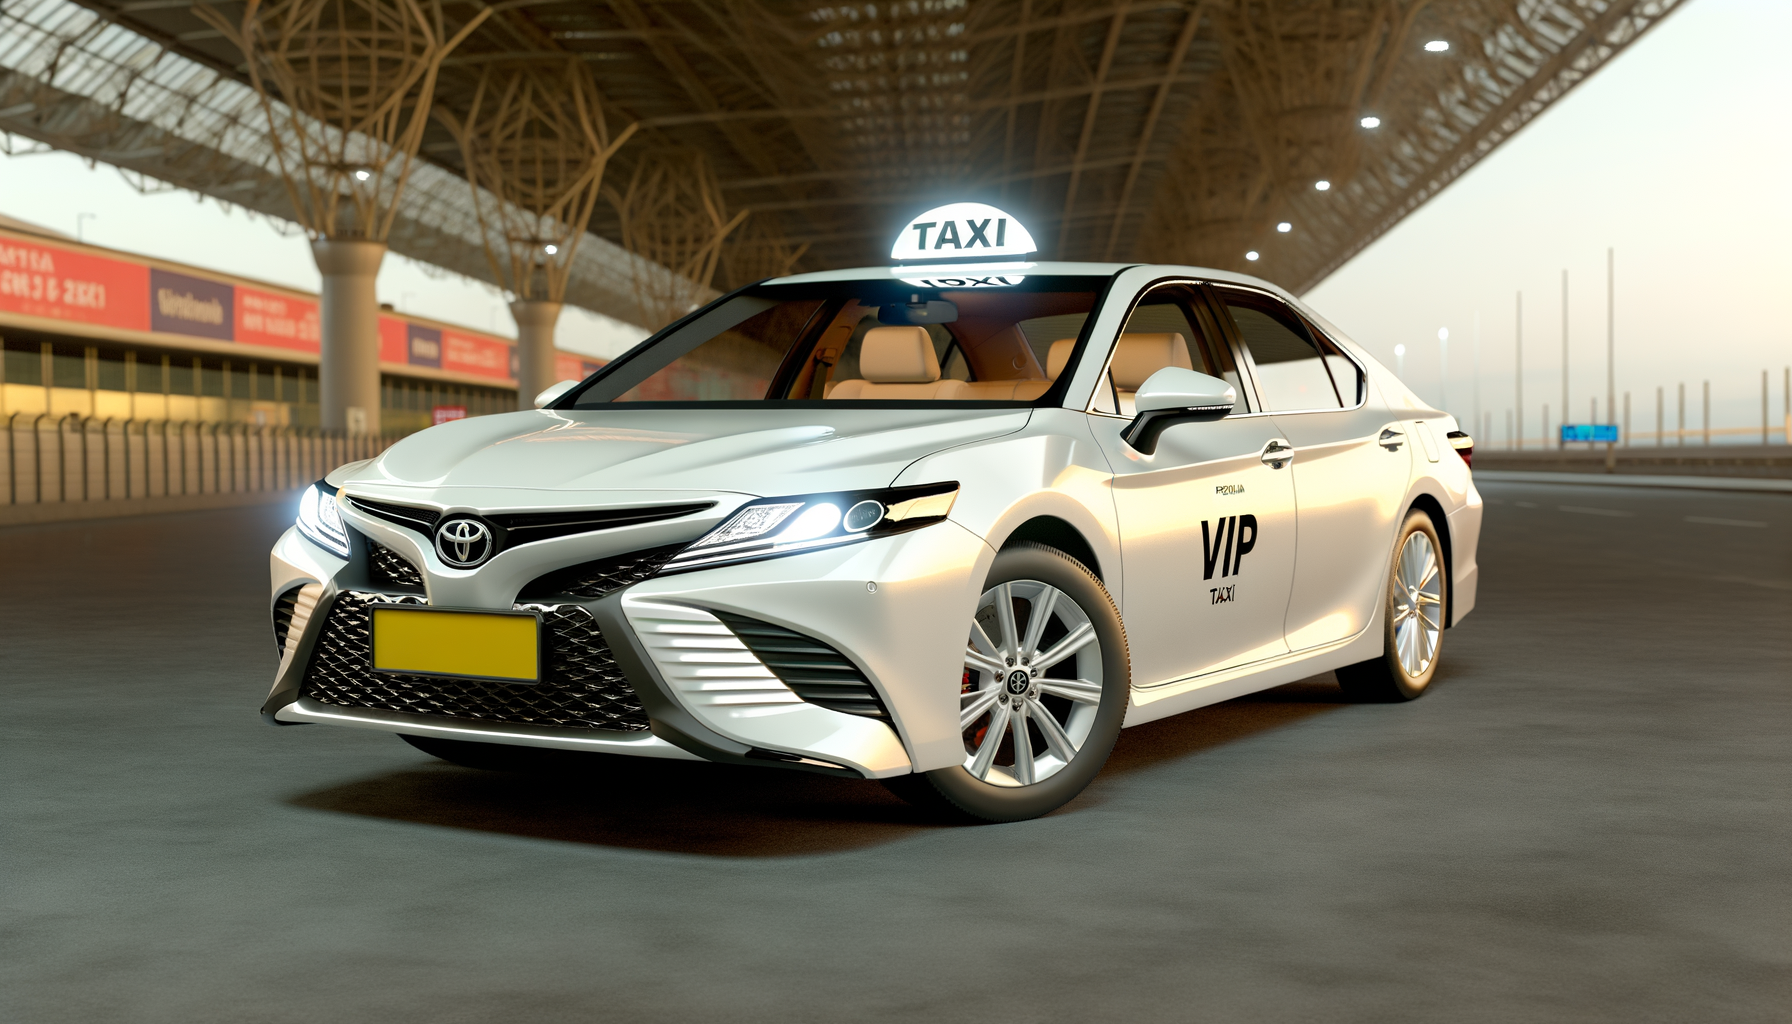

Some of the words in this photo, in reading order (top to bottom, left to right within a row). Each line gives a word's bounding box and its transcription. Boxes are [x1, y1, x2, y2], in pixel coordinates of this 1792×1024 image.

[913, 218, 1006, 250] TAXI
[1201, 514, 1257, 581] VIP
[1210, 584, 1235, 605] TAXI
